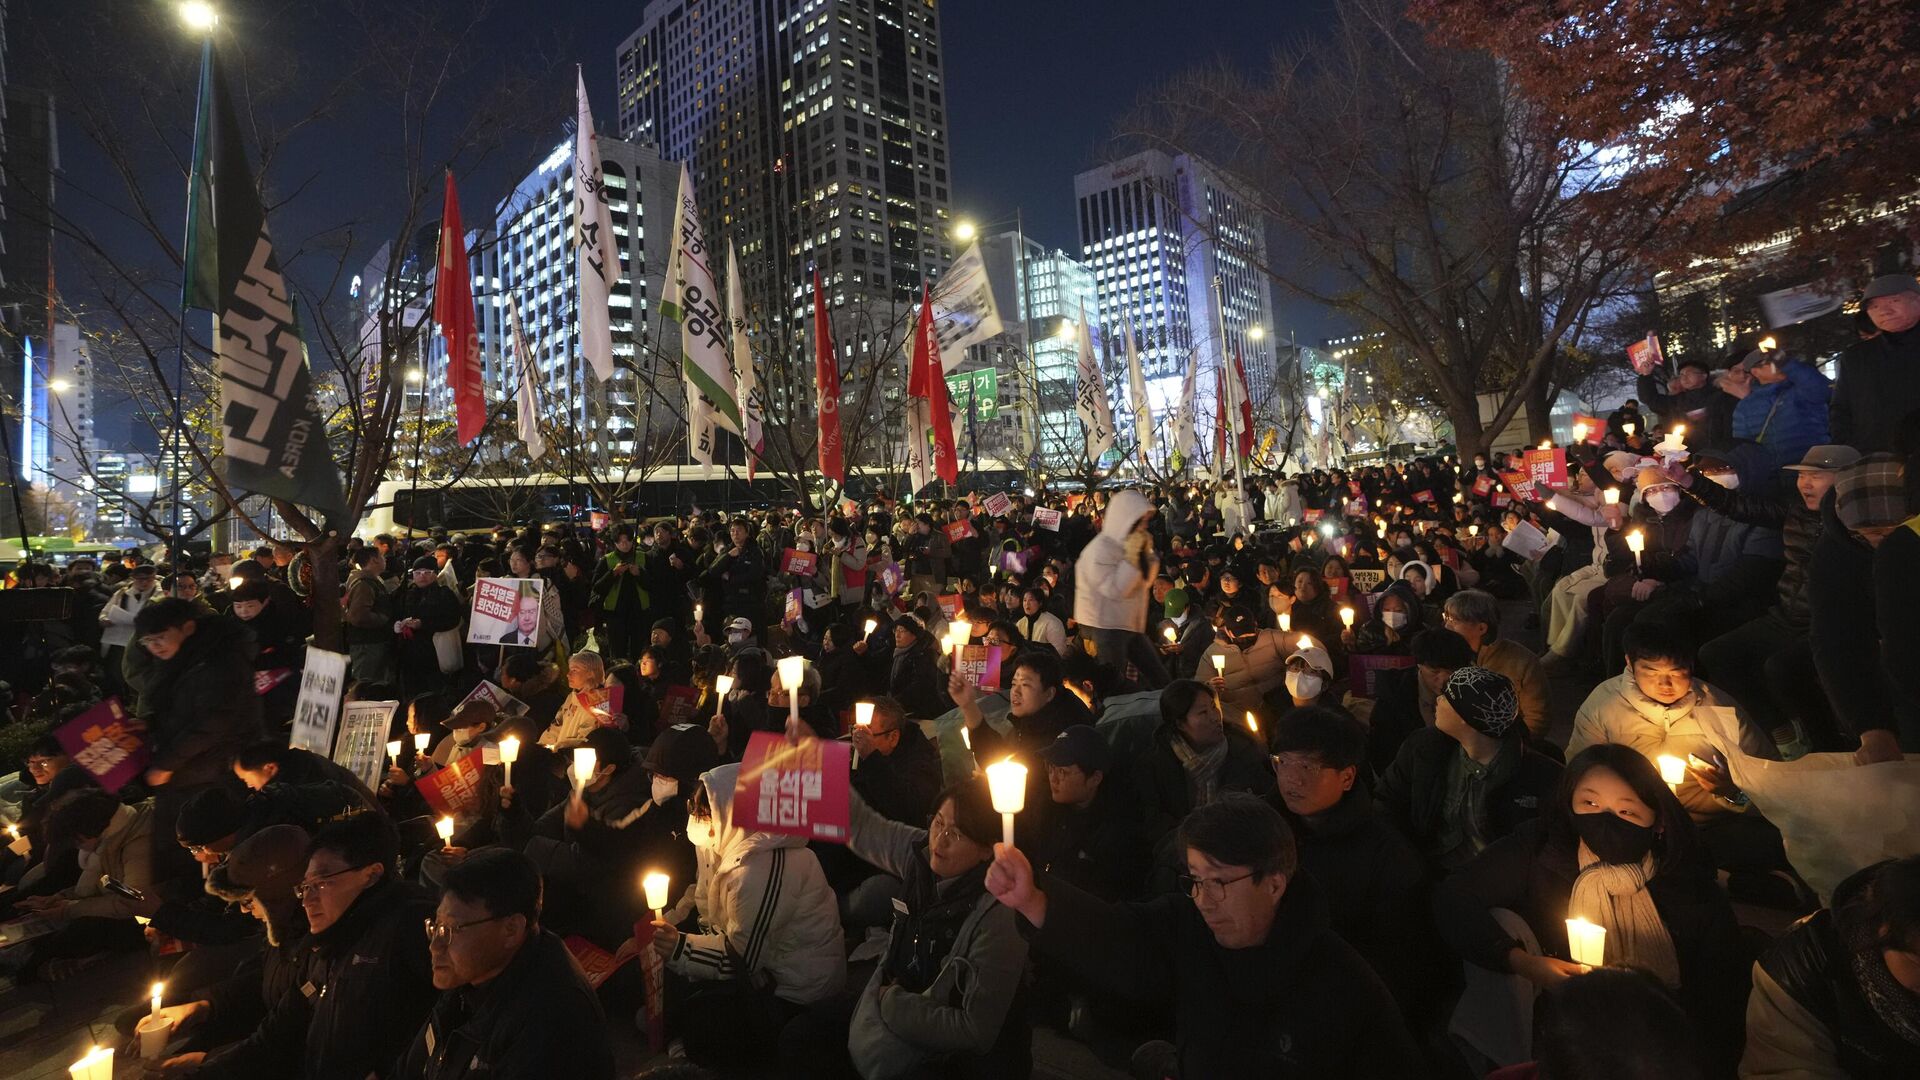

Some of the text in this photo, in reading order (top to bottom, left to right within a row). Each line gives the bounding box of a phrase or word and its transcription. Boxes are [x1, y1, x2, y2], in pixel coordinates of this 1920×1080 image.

[1530, 461, 1555, 475] 윤석열
[480, 582, 516, 605] 윤석열은
[476, 597, 512, 620] 퇴진하라
[299, 700, 331, 730] 퇴진
[760, 769, 822, 800] 윤석열
[757, 797, 808, 828] 퇴진!
